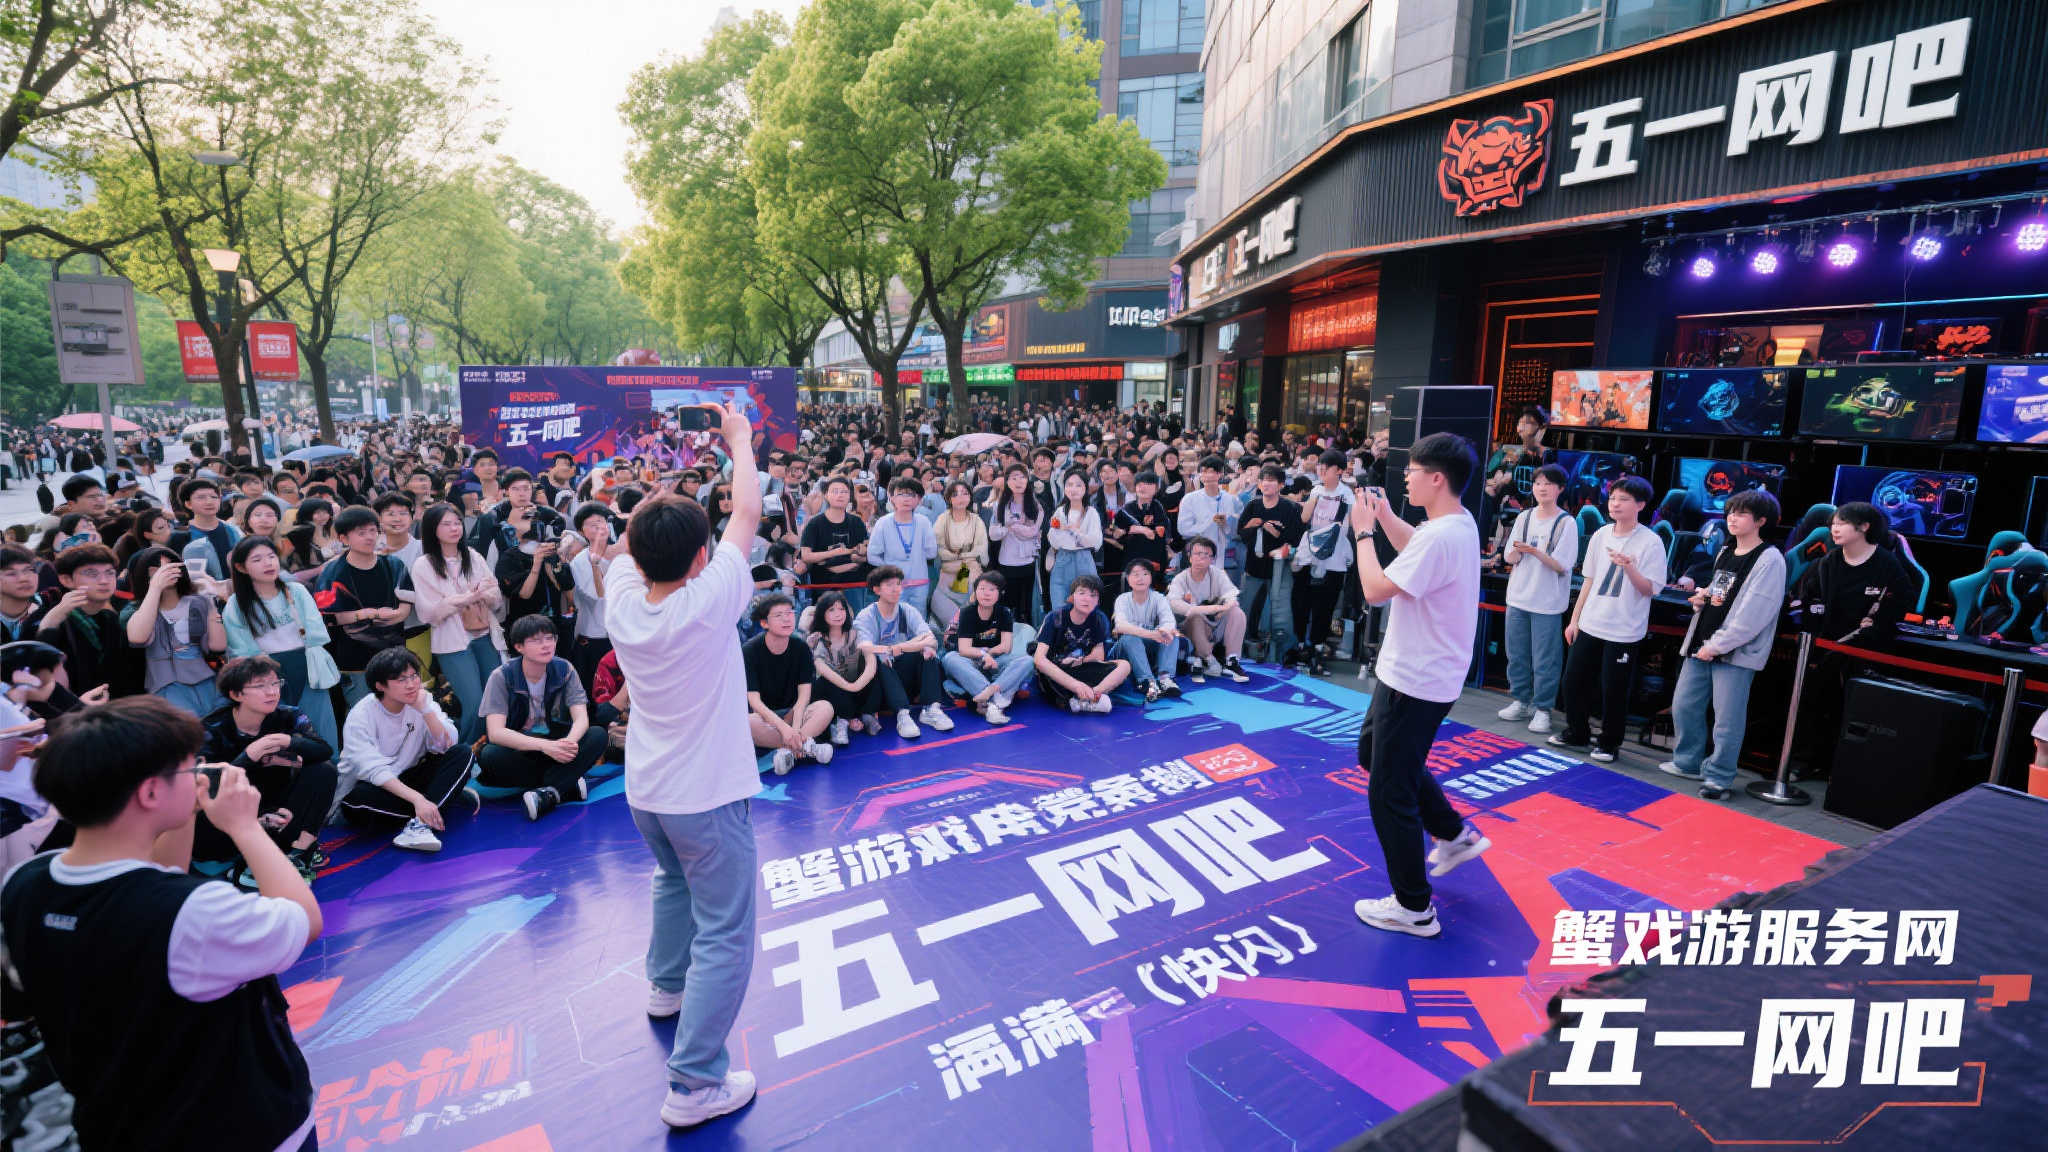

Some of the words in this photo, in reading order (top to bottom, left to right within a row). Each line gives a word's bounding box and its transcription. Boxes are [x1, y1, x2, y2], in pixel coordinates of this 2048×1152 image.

[1560, 17, 1972, 187] 五一网吧
[761, 796, 1331, 1058] 五一网吧
